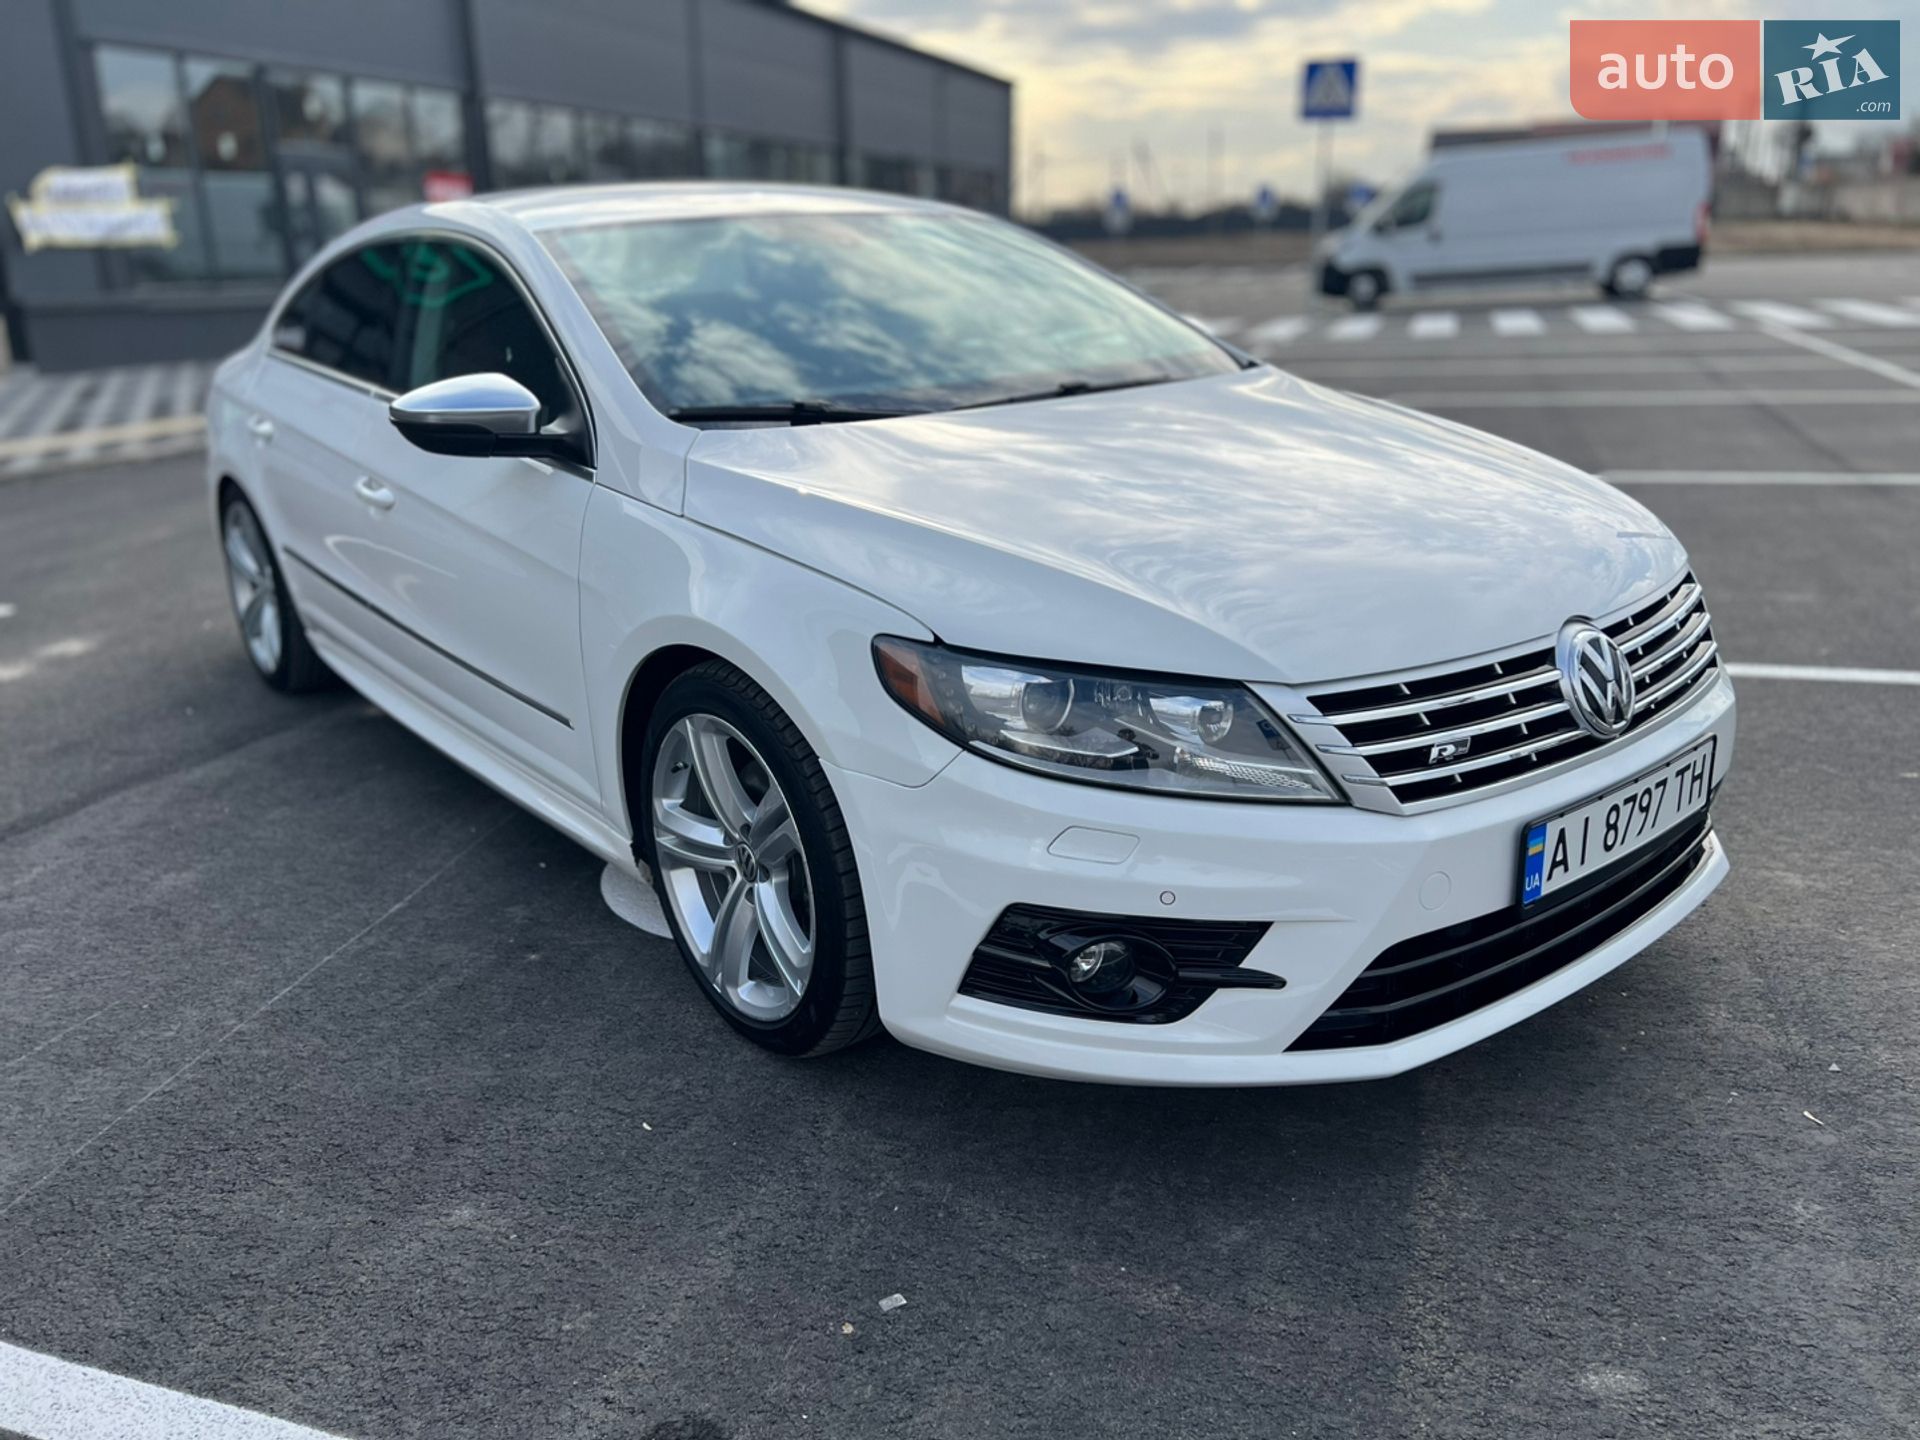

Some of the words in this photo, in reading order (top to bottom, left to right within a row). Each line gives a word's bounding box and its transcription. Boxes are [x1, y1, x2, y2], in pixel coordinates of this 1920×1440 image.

[1547, 816, 1590, 882] AI
[1603, 777, 1668, 853] 8797
[1675, 753, 1707, 813] TH
[1525, 872, 1540, 892] UA
